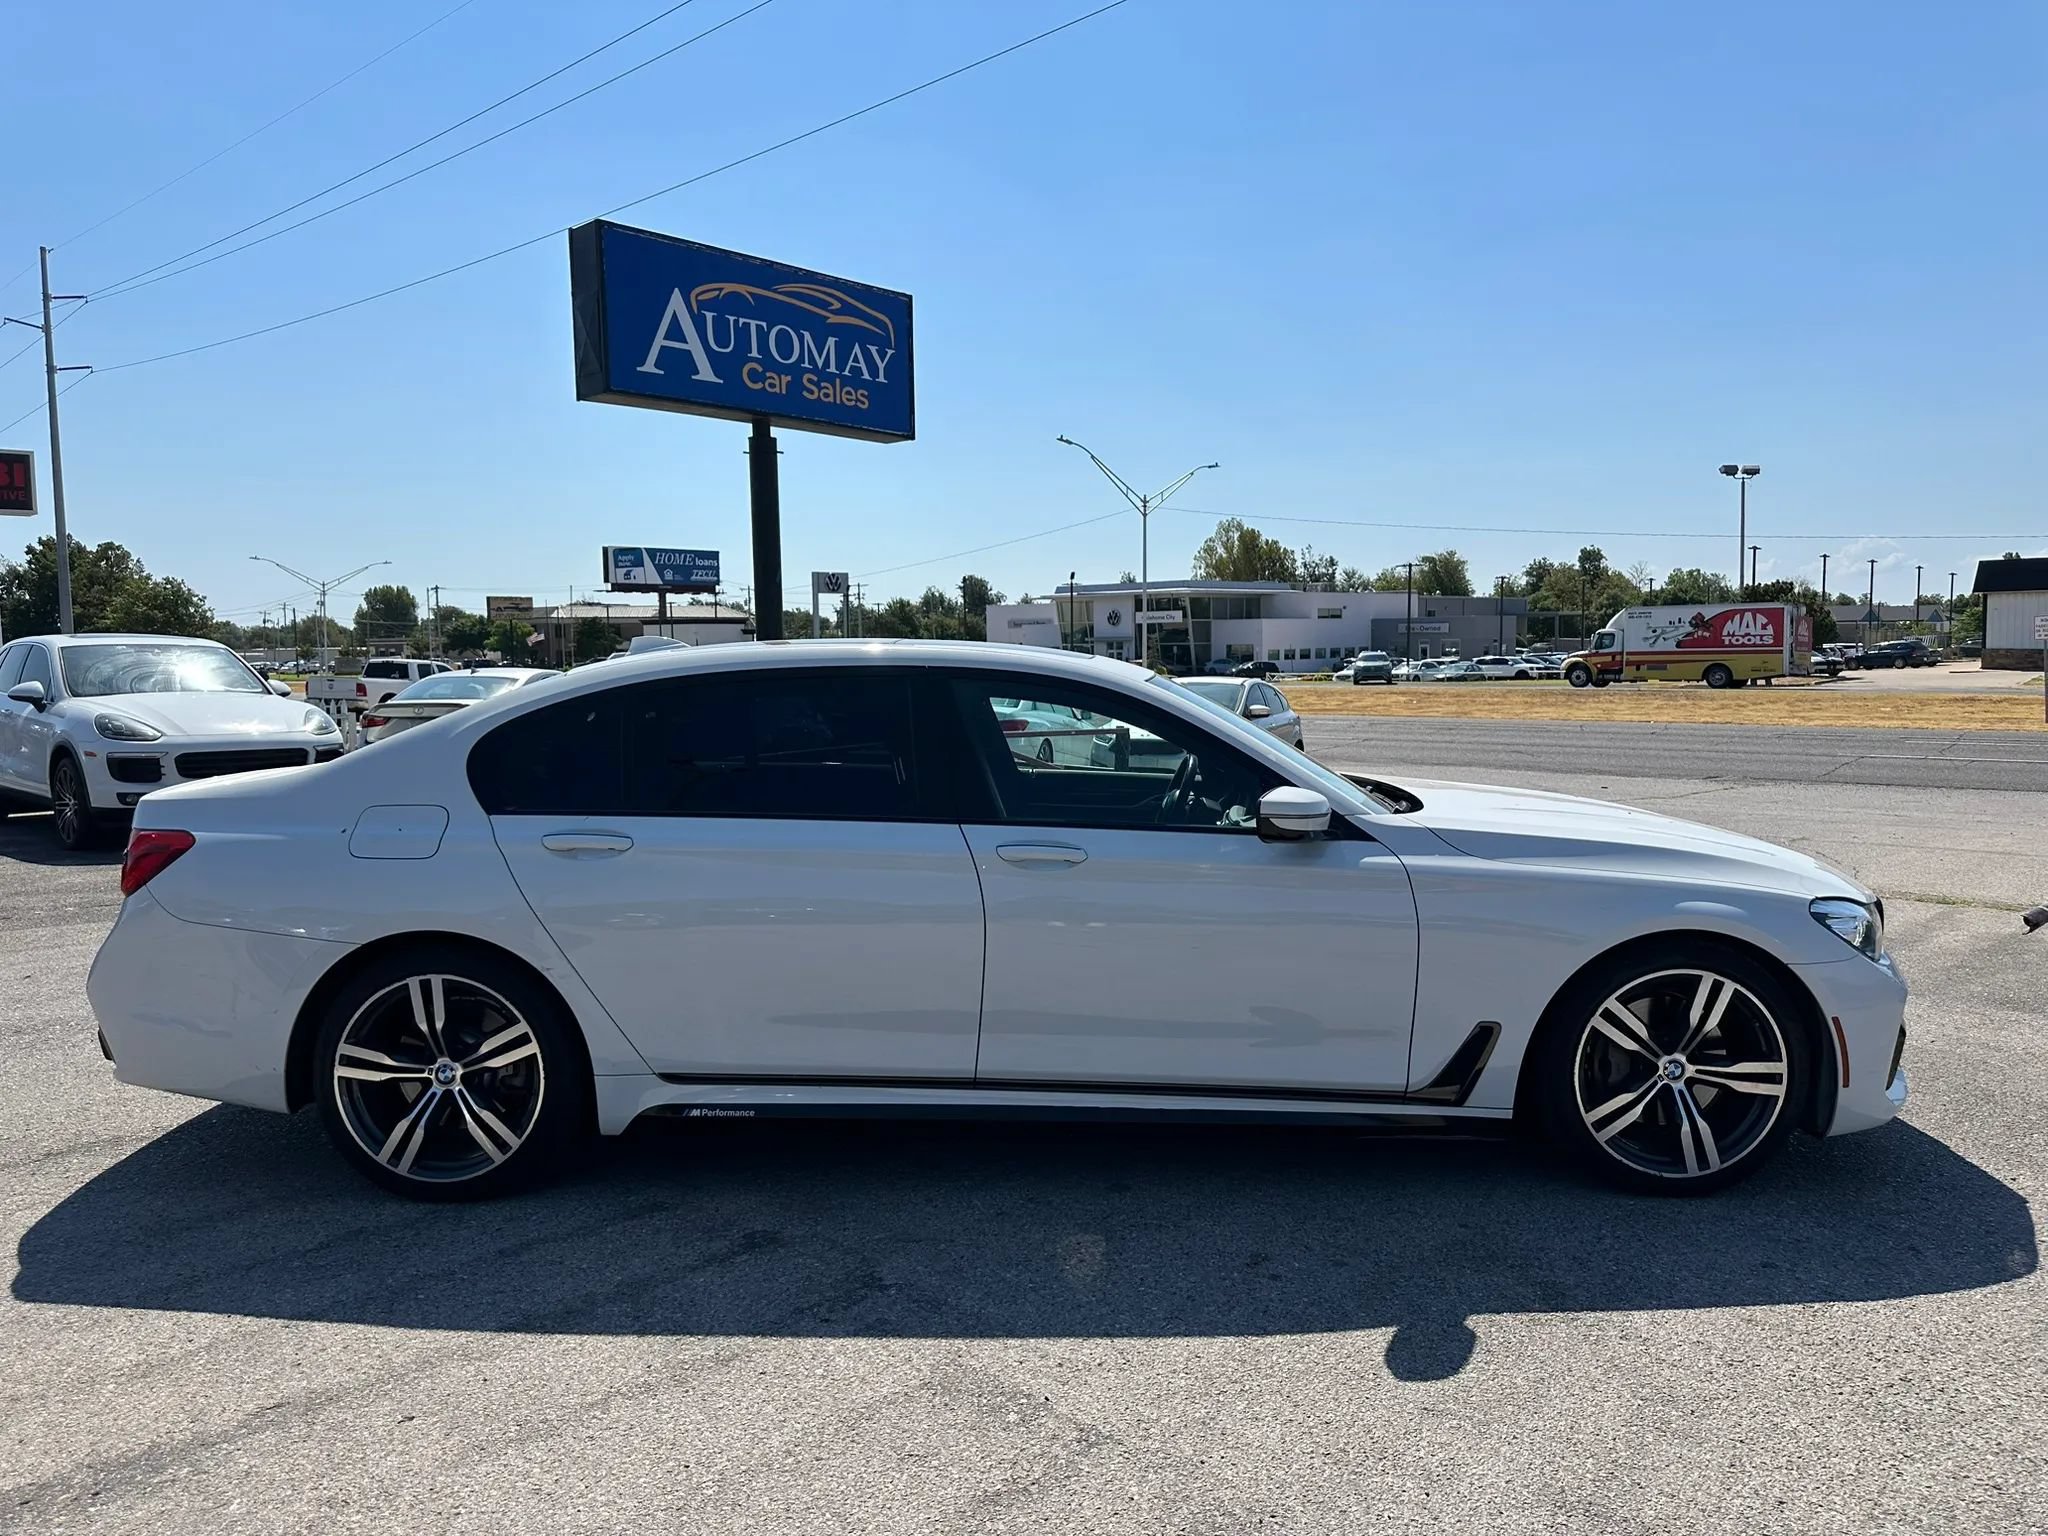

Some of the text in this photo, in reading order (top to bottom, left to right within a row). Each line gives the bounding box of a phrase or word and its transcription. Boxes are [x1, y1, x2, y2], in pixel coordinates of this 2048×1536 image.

[742, 362, 870, 410] Car Sales
[617, 554, 634, 562] Apply
[654, 552, 718, 567] HOME loans
[1722, 612, 1774, 636] MAC
[1722, 635, 1774, 645] TOOLS
[701, 1108, 755, 1117] Performance
